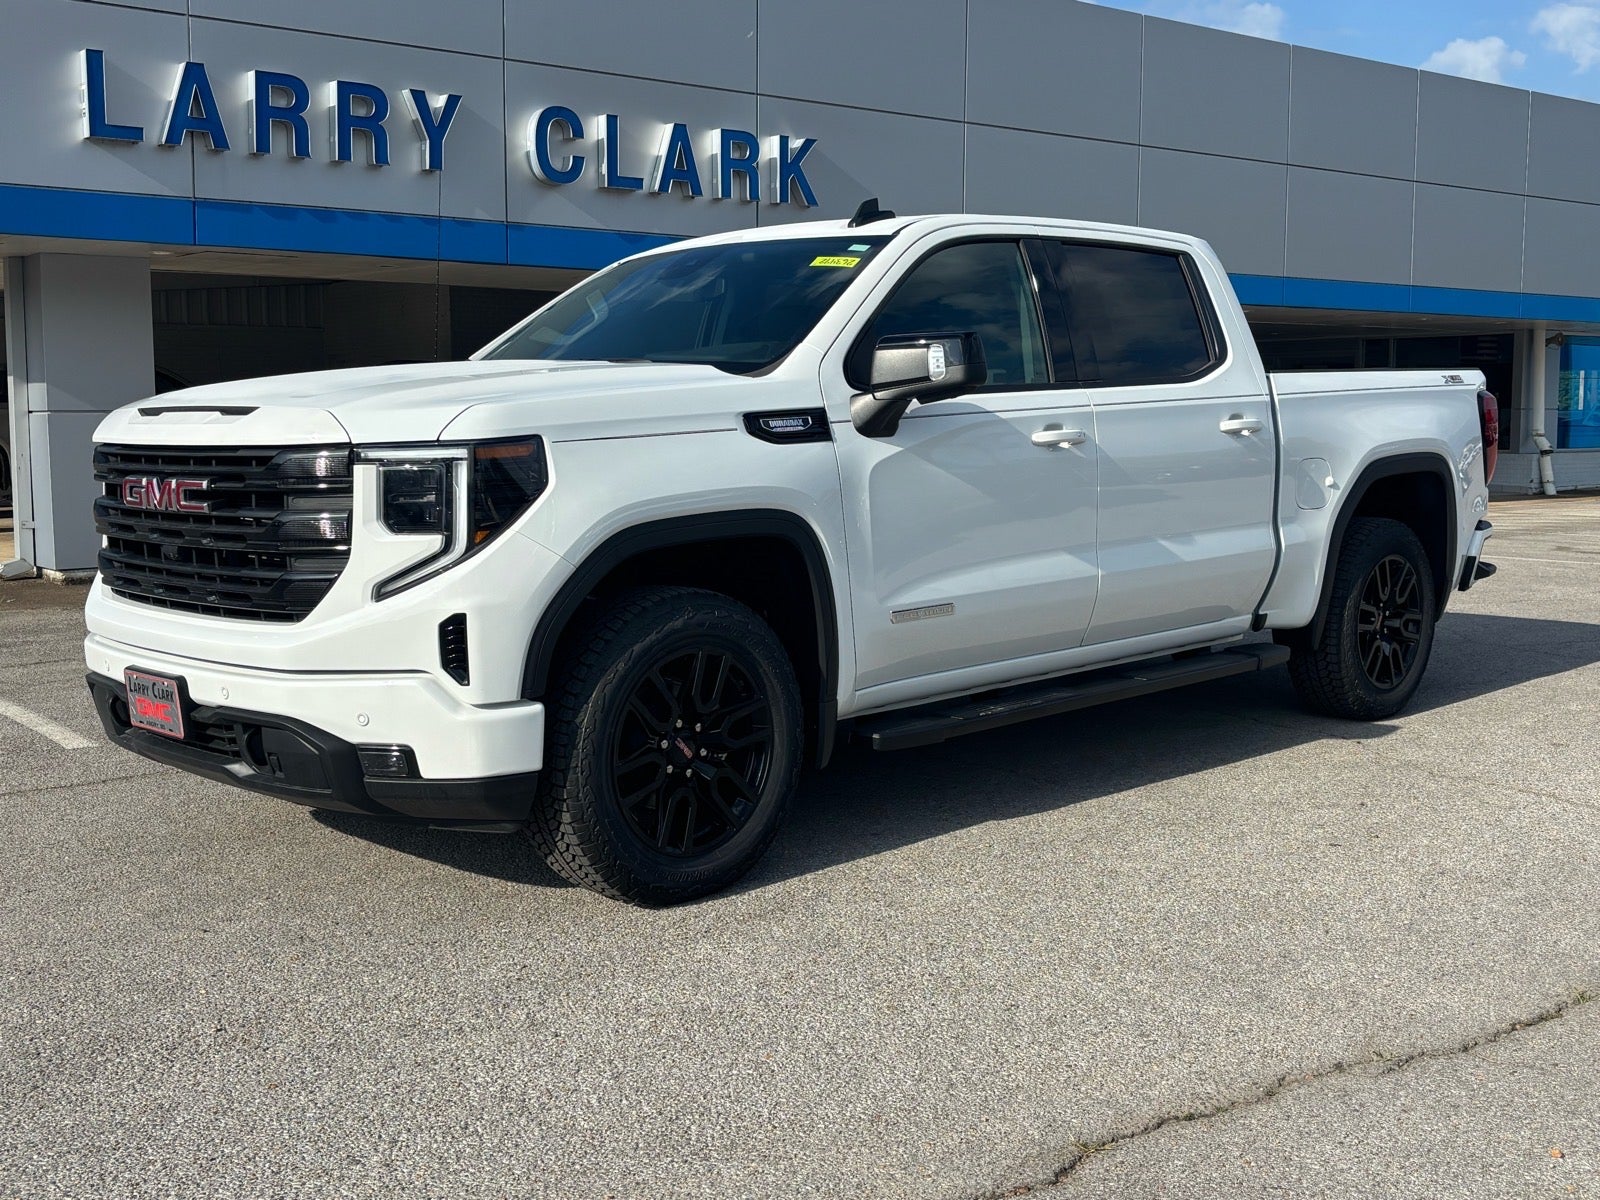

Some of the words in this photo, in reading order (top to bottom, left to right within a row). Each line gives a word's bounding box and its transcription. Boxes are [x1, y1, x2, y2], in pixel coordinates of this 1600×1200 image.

[80, 48, 463, 172] LARRY
[527, 105, 819, 206] CLARK
[122, 476, 209, 514] GMC
[128, 676, 149, 697] LARRY
[151, 682, 175, 703] CLARK
[135, 696, 172, 723] GMC
